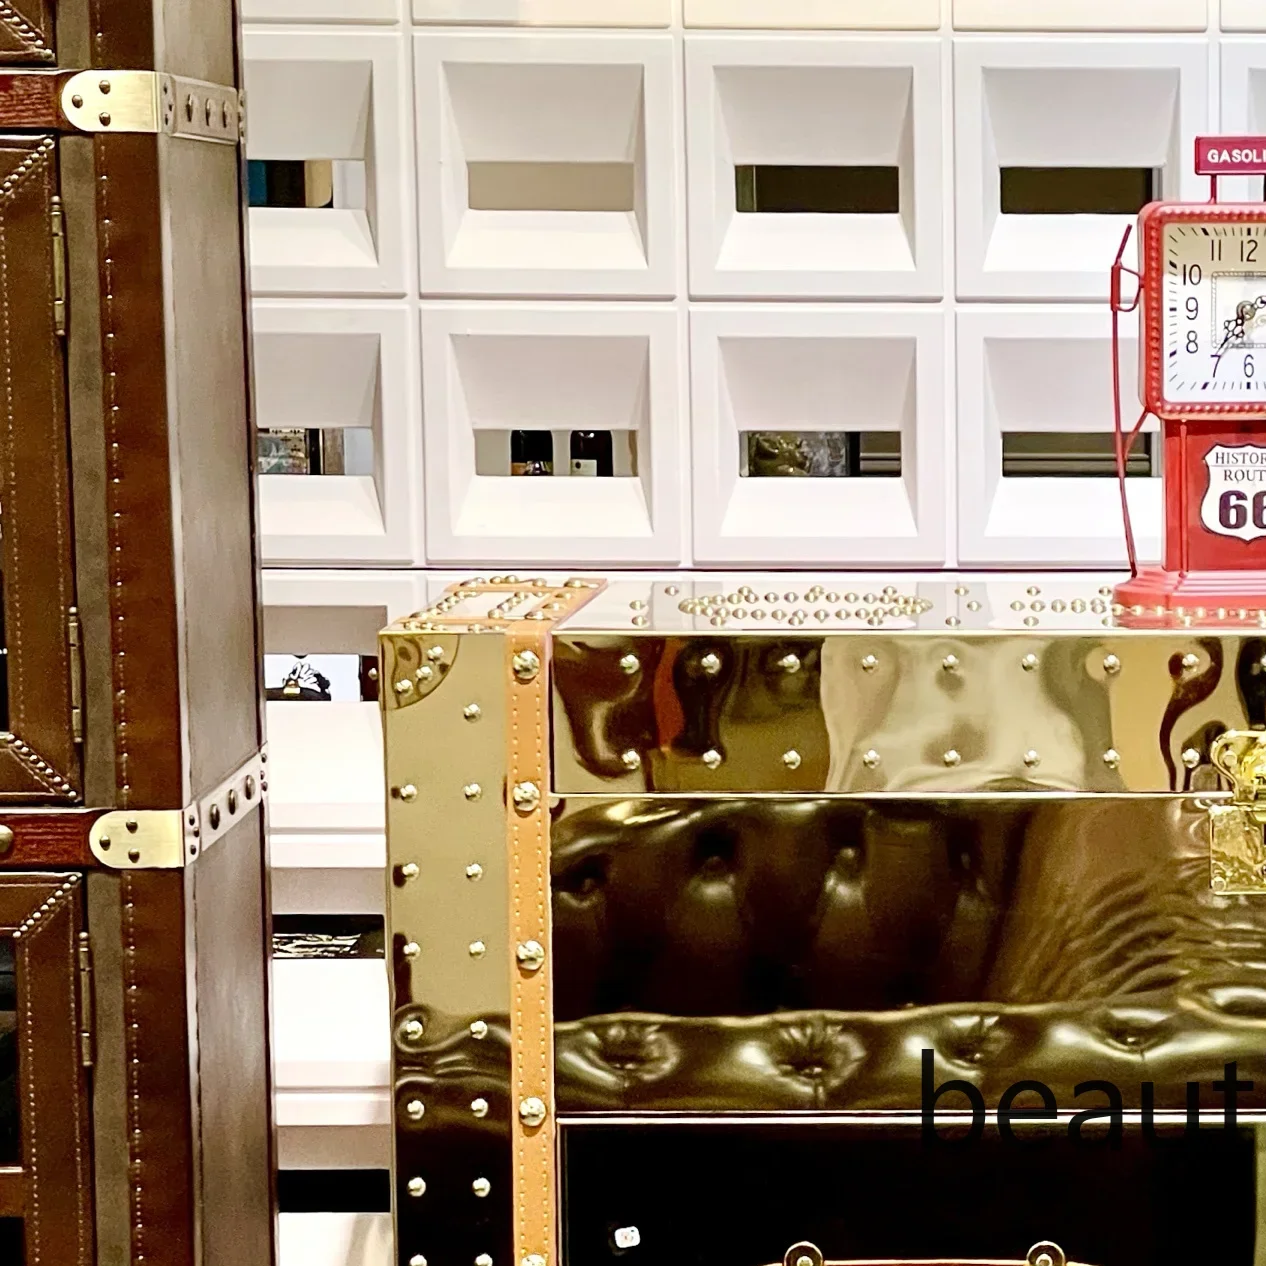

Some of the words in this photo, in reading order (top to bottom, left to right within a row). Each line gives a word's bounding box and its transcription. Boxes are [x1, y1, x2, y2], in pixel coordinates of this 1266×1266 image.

[1210, 239, 1222, 262] 11
[1240, 239, 1257, 262] 12
[1182, 264, 1202, 286] 10
[1185, 297, 1199, 320] 9
[1185, 330, 1199, 354] 8
[1210, 354, 1222, 378] 7
[1243, 354, 1255, 378] 6
